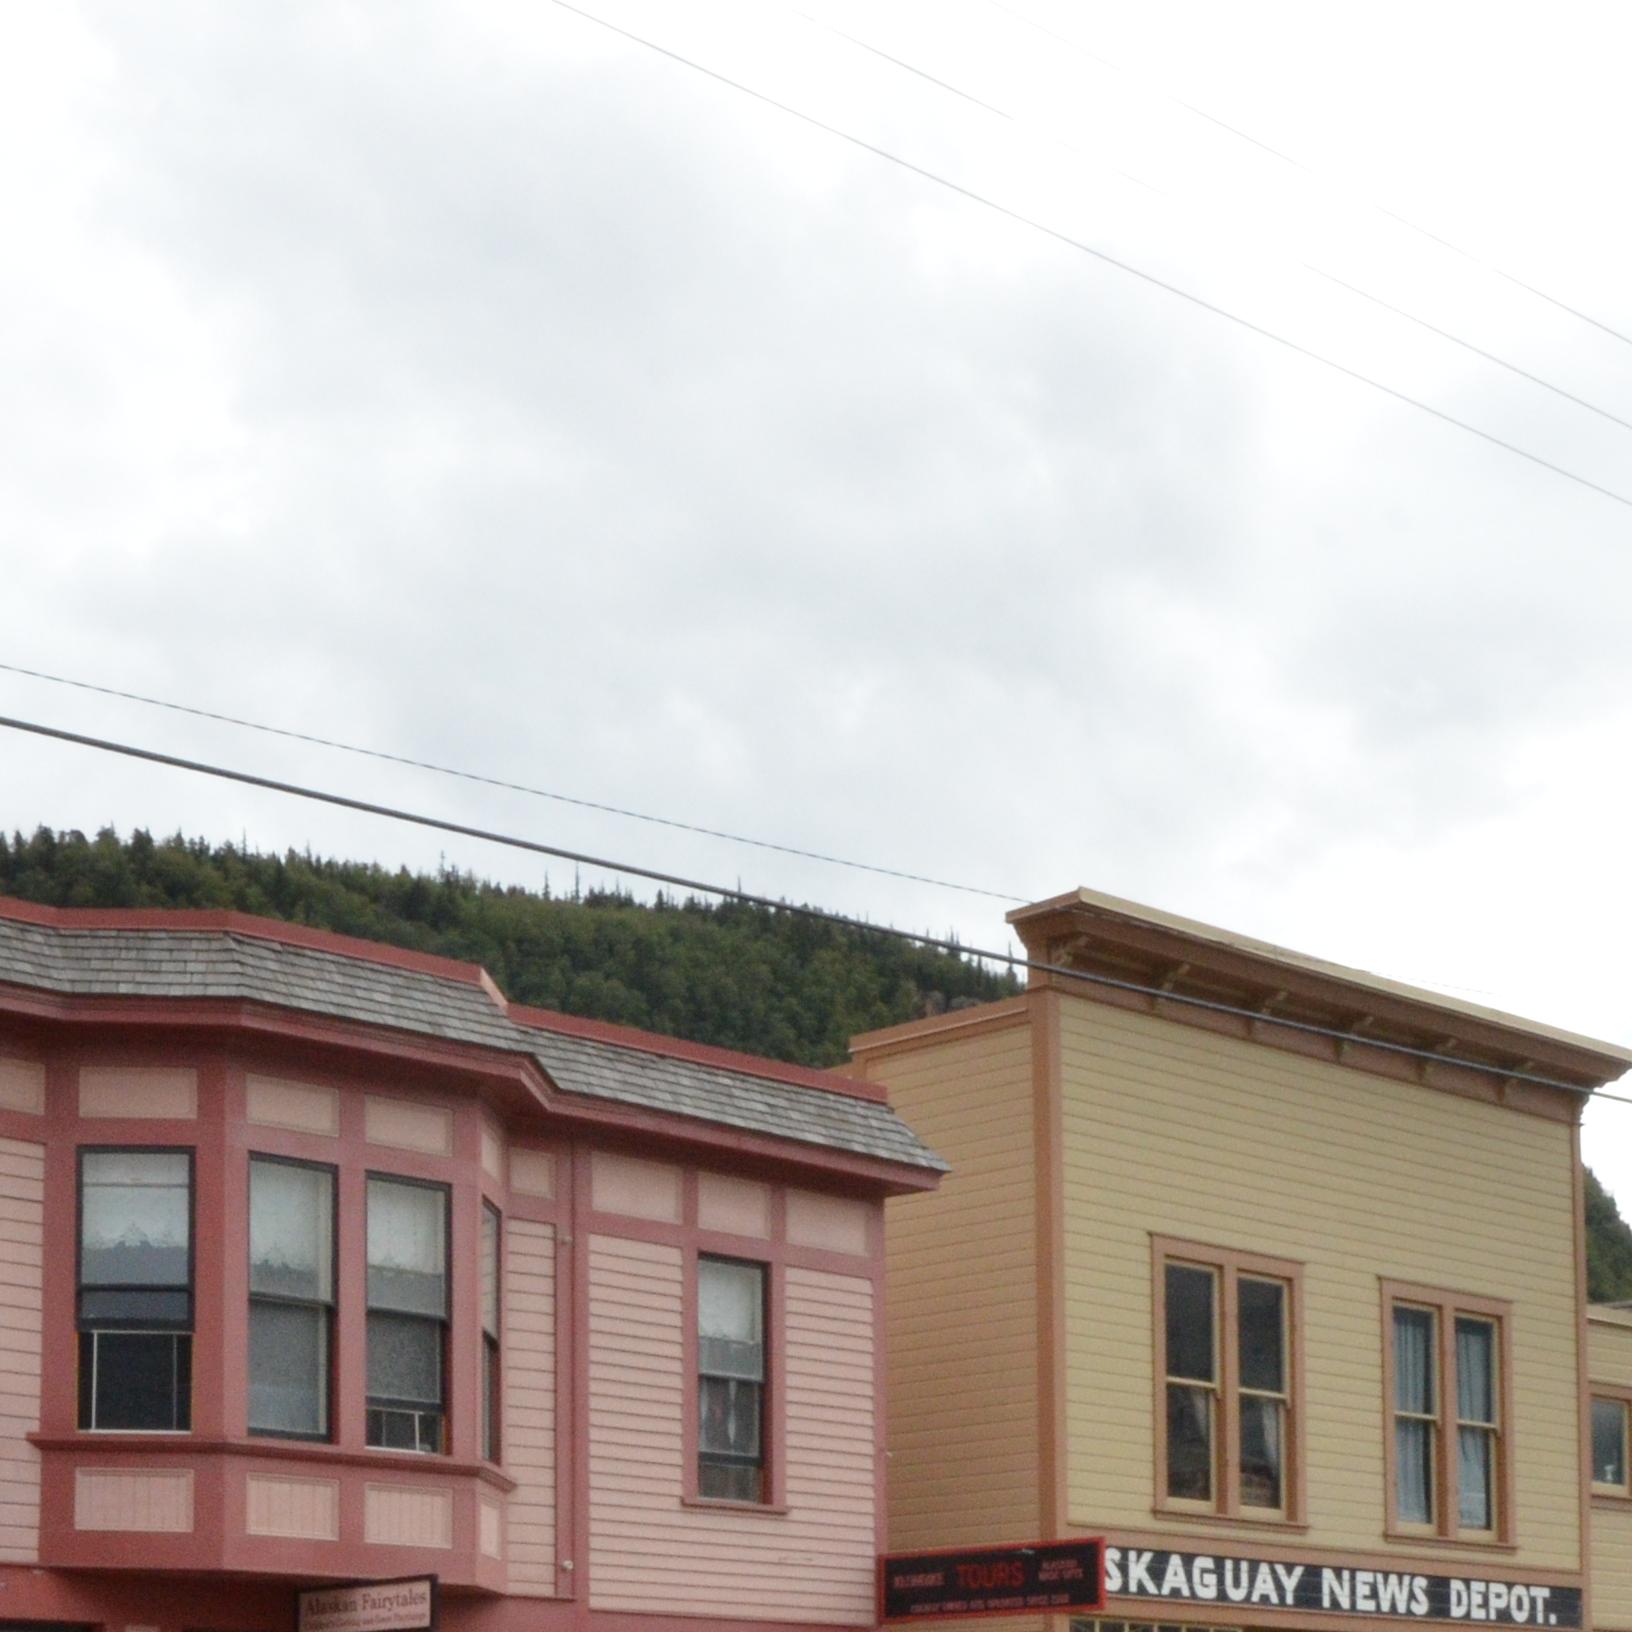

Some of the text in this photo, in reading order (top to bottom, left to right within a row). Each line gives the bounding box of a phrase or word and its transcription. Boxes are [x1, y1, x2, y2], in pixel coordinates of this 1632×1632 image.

[956, 1560, 1026, 1590] TOURS
[1103, 1547, 1305, 1606] SKAGUAY
[1321, 1567, 1428, 1616] NEWS
[1449, 1578, 1558, 1626] DEPOT.
[361, 1588, 427, 1612] Fairytales
